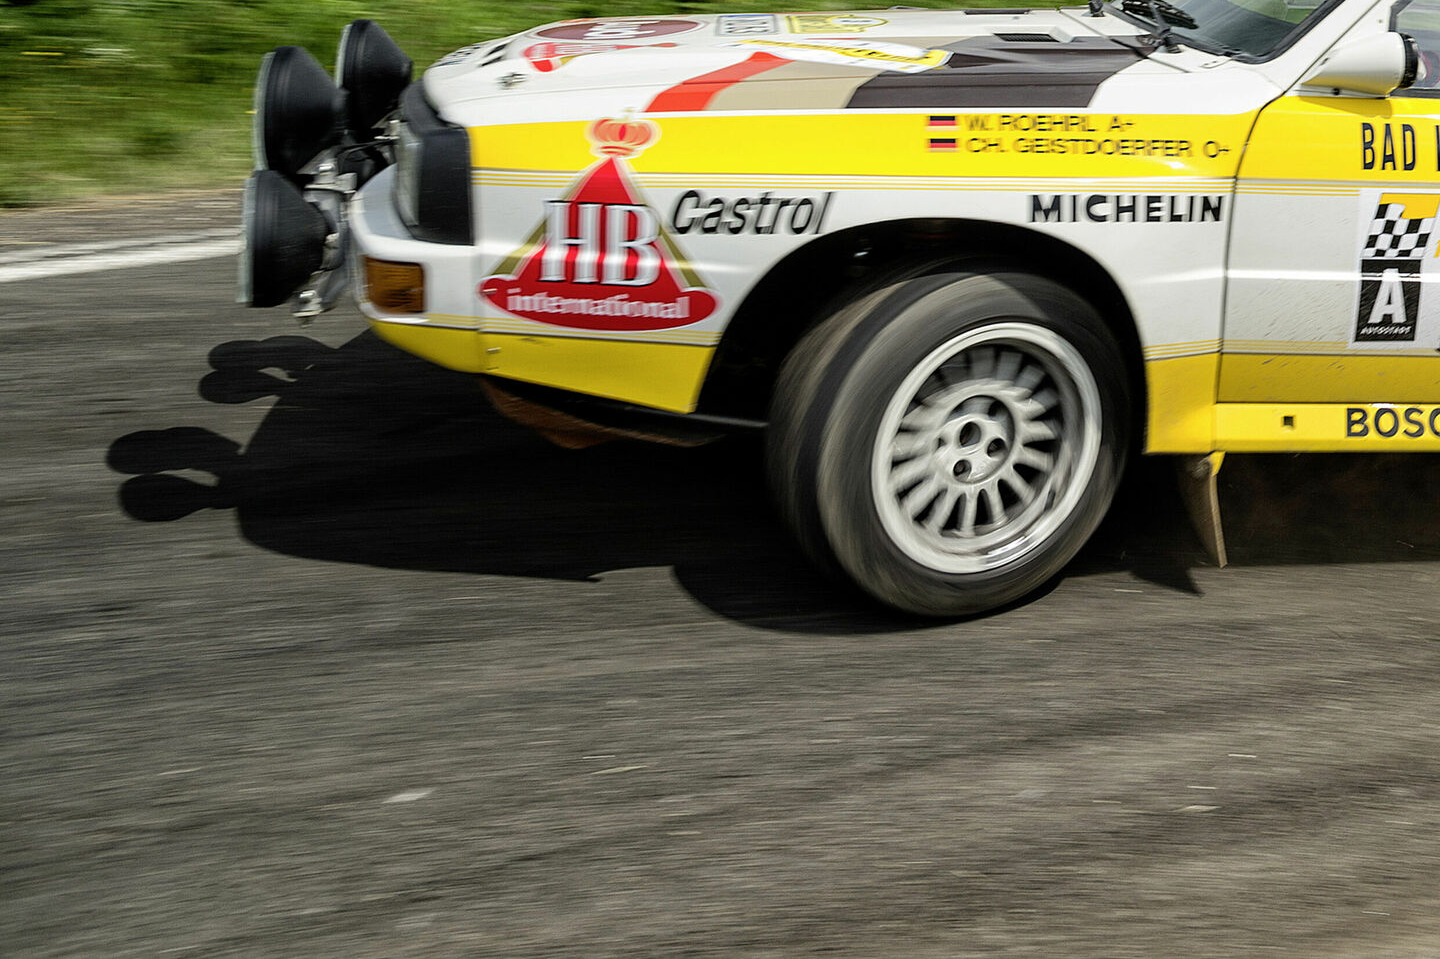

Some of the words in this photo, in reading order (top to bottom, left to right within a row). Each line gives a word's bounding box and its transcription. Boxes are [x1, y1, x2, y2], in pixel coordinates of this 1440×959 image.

[1000, 114, 1098, 132] ROEHRL
[1014, 138, 1193, 157] GEISTDOERFER
[1362, 122, 1416, 171] BAD
[673, 189, 837, 235] Castrol
[1028, 194, 1225, 223] MICHELIN
[538, 199, 661, 287] HB
[507, 288, 690, 320] international
[1367, 268, 1408, 324] A
